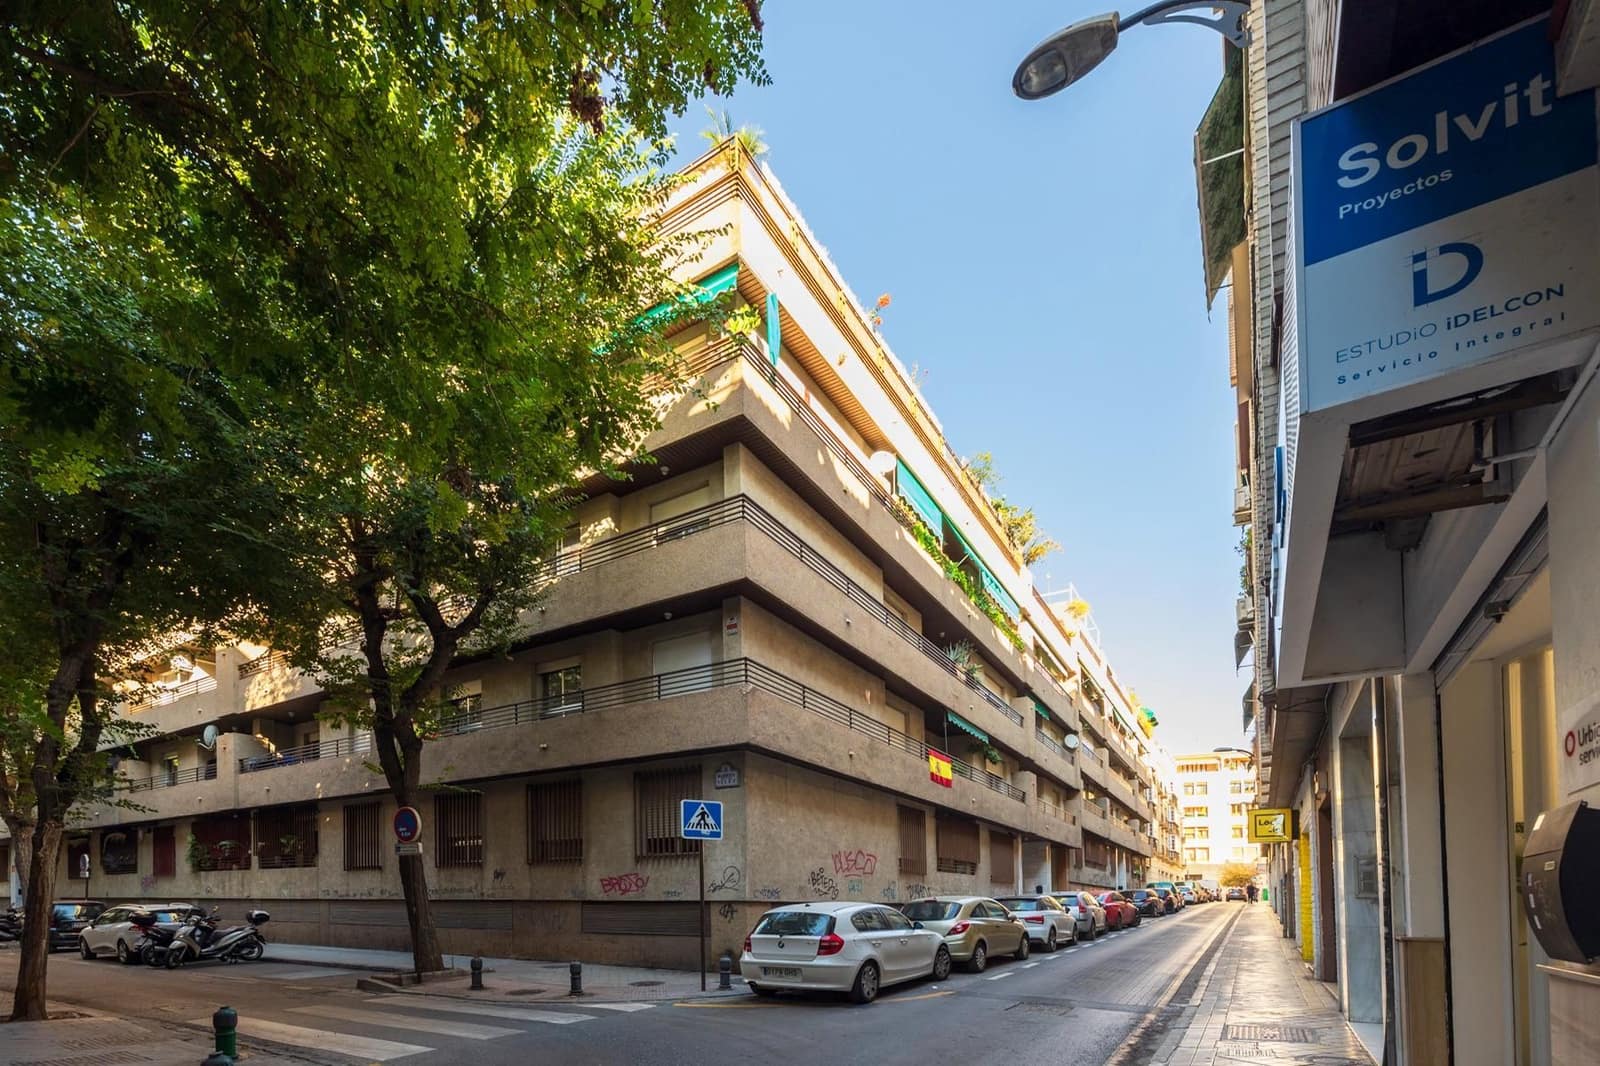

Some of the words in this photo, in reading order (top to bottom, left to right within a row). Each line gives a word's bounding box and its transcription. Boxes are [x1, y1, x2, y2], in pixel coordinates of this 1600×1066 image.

[1336, 72, 1553, 190] Solvit
[1338, 168, 1453, 220] Proyectos
[1336, 322, 1438, 364] ESTUDiO
[1446, 284, 1565, 331] iDELCON
[1337, 350, 1439, 385] Servicio
[1455, 311, 1567, 351] Integral
